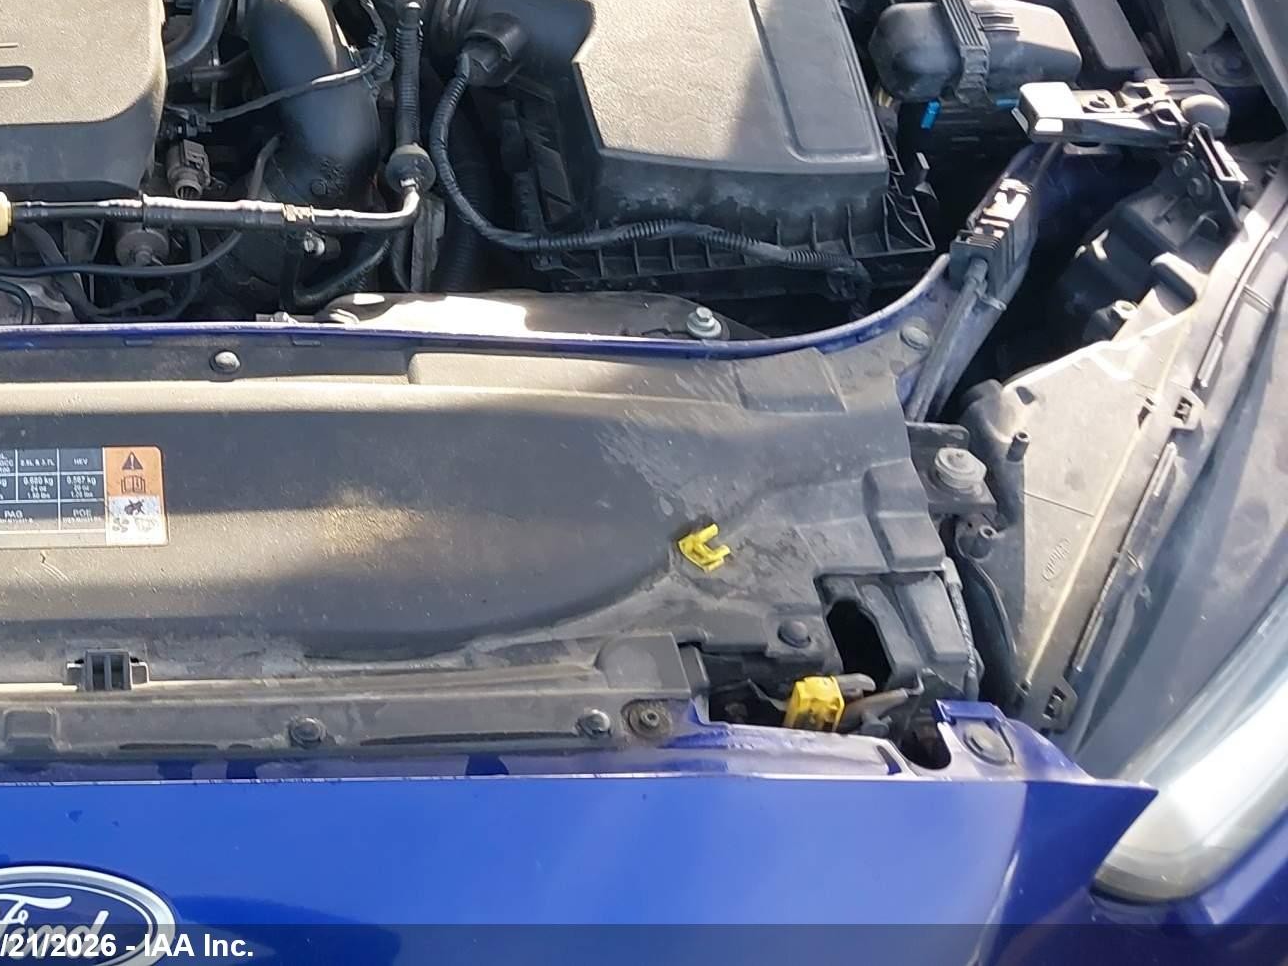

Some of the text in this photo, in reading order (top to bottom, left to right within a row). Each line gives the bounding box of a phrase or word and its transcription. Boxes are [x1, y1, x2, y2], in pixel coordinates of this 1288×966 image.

[44, 476, 53, 486] kg
[87, 475, 97, 485] kg
[4, 510, 23, 519] PAG
